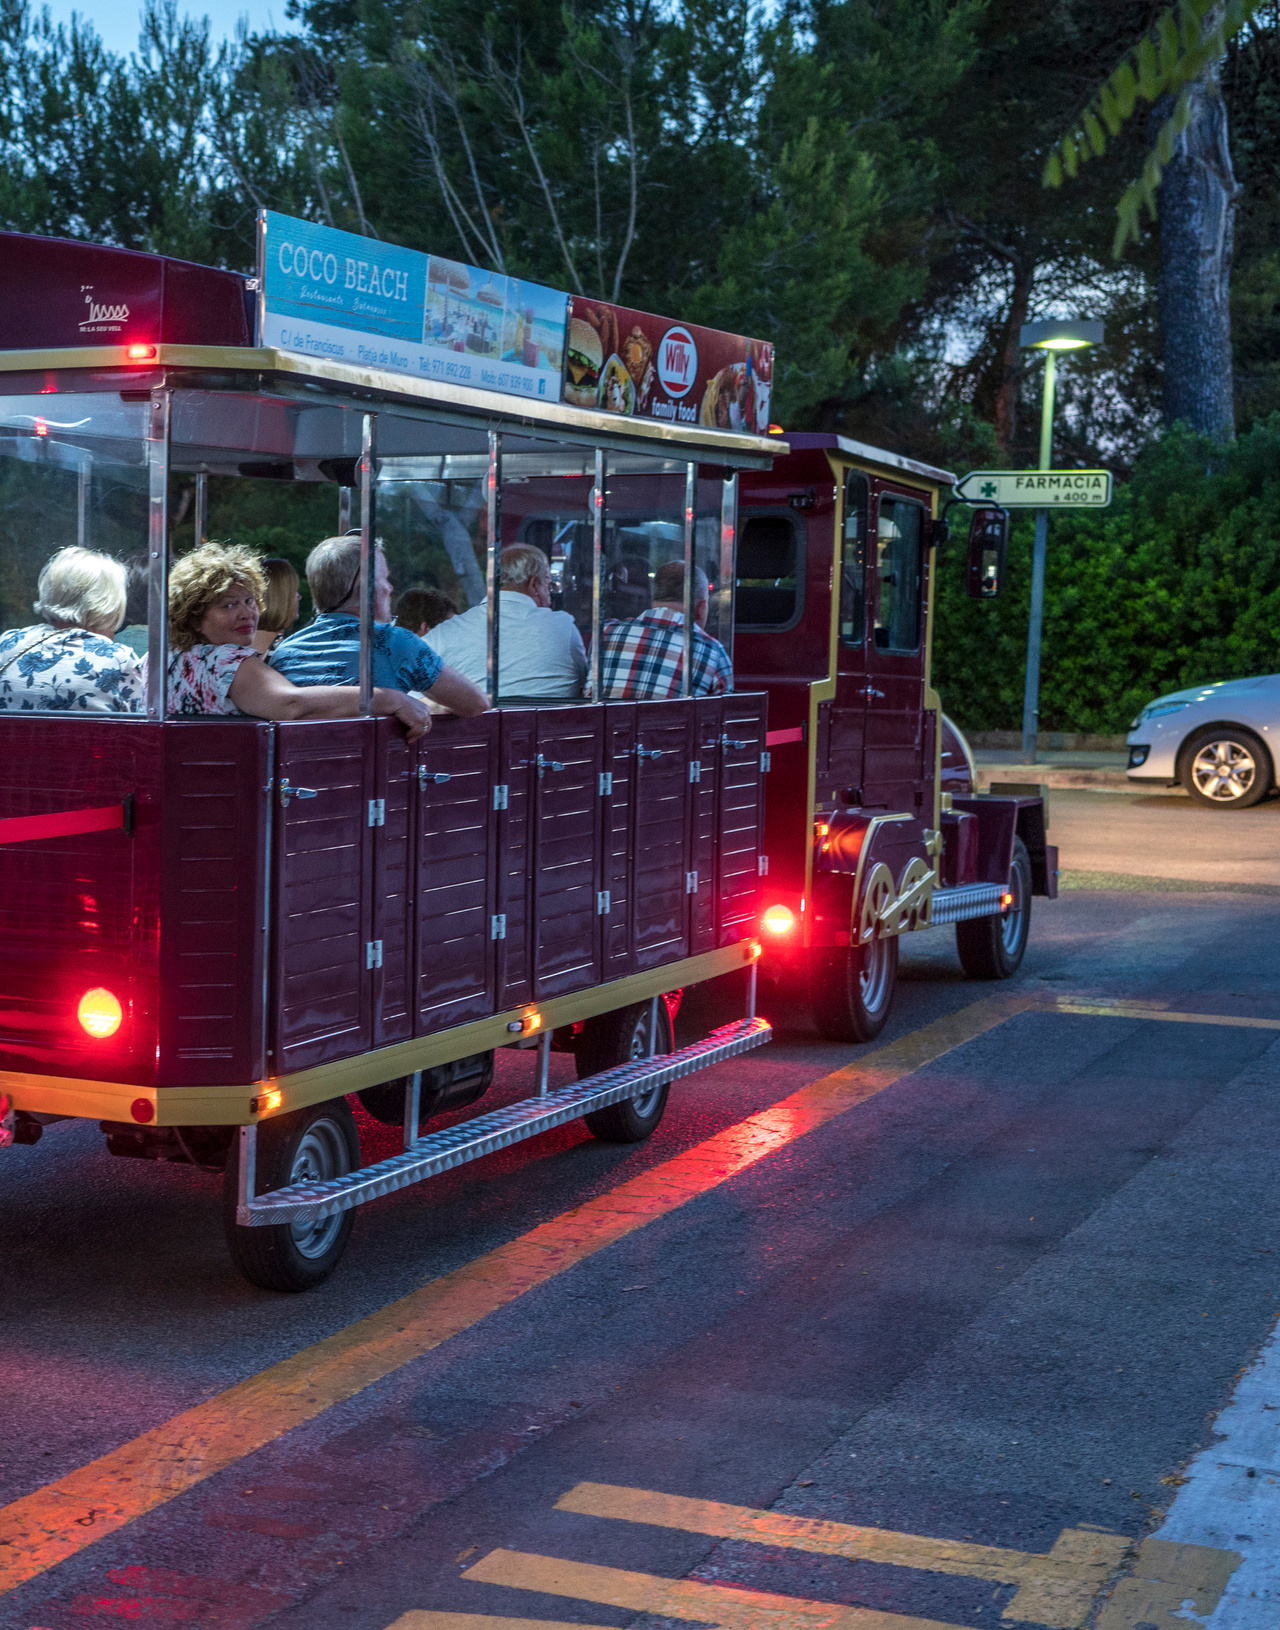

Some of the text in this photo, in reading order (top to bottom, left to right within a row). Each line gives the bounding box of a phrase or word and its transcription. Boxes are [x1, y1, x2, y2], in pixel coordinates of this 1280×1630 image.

[278, 242, 409, 301] COCO BEACH
[294, 331, 304, 348] de
[379, 349, 389, 364] de
[390, 350, 409, 368] Muro
[432, 359, 445, 374] 971
[665, 343, 690, 382] Willy
[652, 396, 697, 422] family food
[1015, 477, 1102, 489] FARMACIA
[1063, 492, 1088, 501] 400
